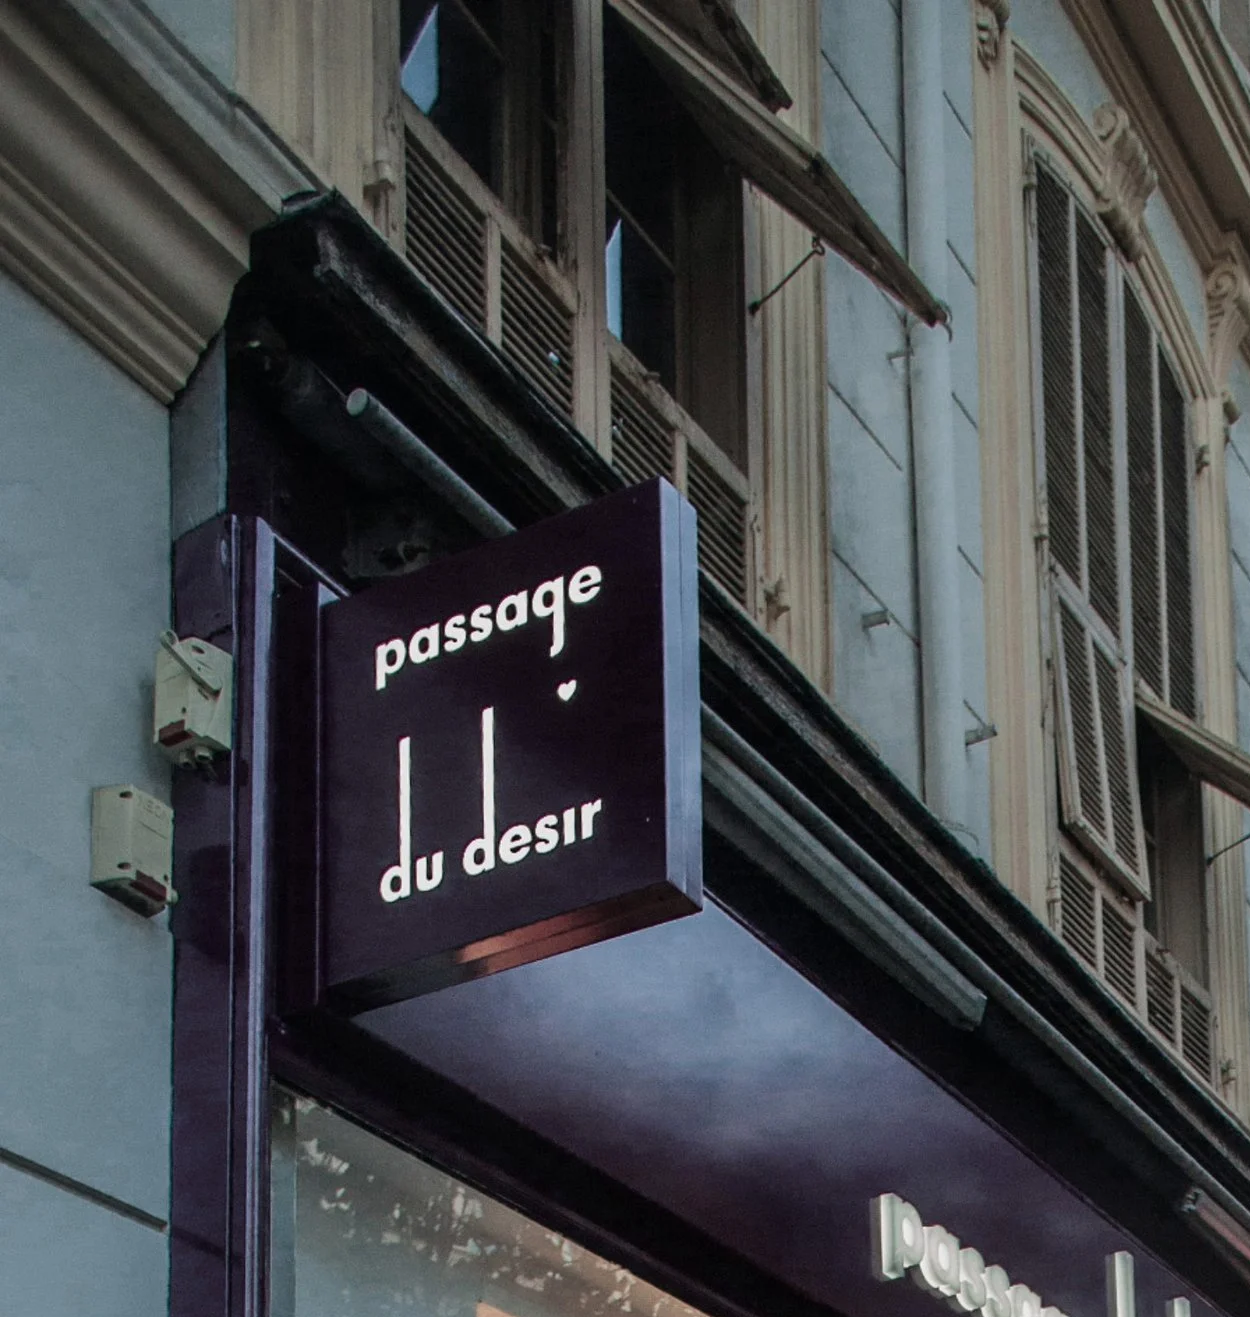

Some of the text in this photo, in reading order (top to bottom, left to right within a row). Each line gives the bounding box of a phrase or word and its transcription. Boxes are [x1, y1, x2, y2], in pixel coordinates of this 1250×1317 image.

[374, 564, 602, 691] passage
[379, 706, 602, 903] du desir
